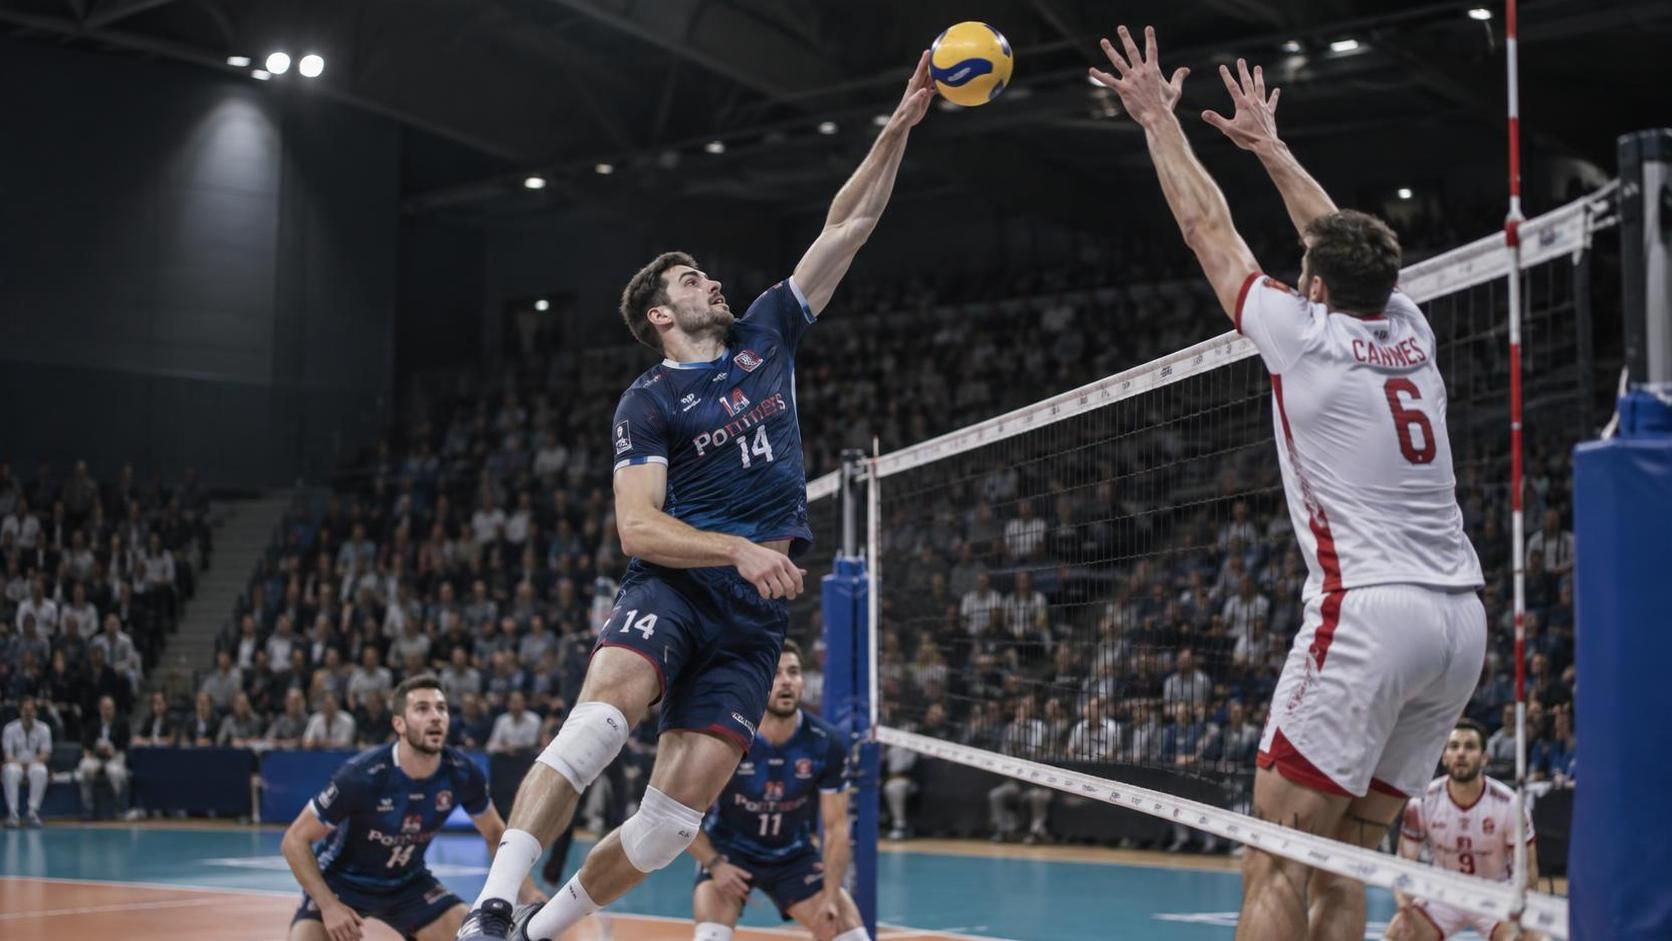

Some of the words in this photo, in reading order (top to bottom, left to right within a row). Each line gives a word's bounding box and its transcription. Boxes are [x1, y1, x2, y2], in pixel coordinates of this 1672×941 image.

[1352, 336, 1427, 367] CANNES
[1383, 376, 1437, 465] 6
[735, 424, 774, 469] 14
[619, 609, 659, 640] 14
[758, 813, 782, 836] 11
[1458, 852, 1476, 876] 9
